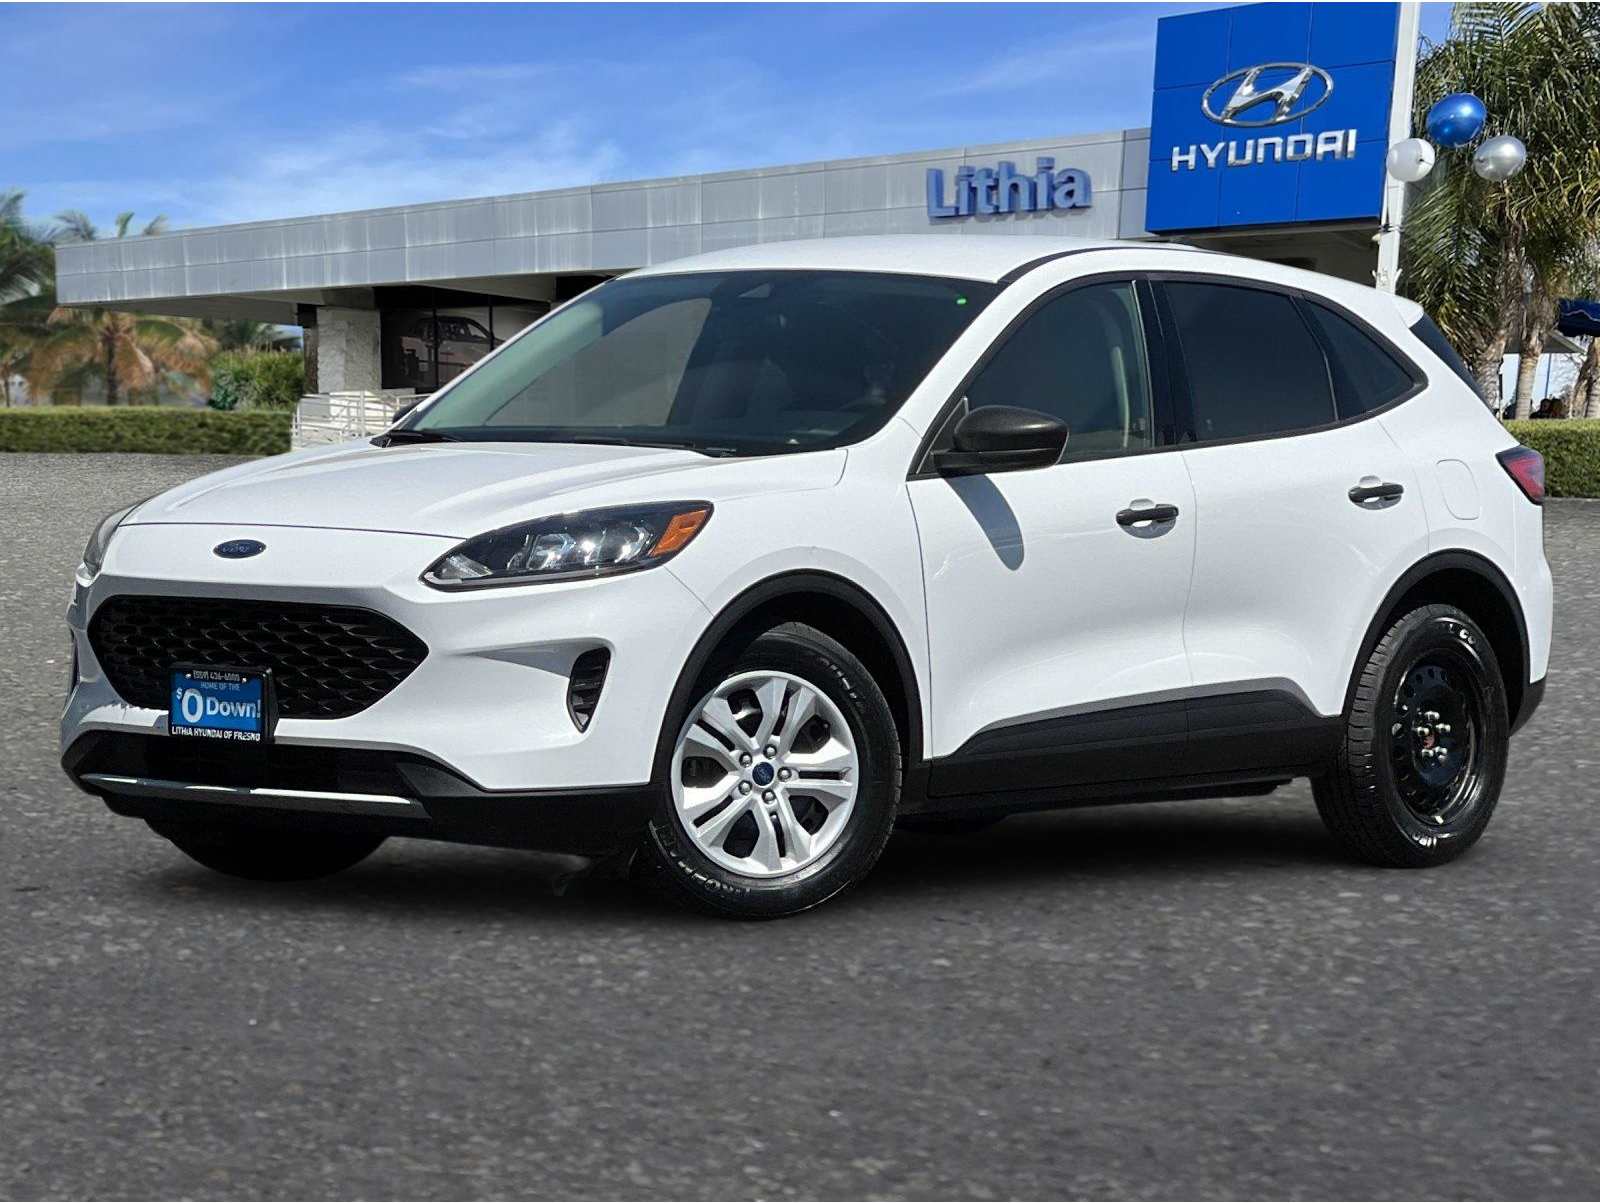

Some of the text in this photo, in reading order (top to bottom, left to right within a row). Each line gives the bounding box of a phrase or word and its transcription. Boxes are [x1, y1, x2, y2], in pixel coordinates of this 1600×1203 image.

[1171, 128, 1357, 172] HYUNDAI
[926, 157, 1092, 218] Lithia
[229, 683, 240, 691] THE
[206, 696, 261, 719] Down!
[171, 726, 193, 736] LITHIA
[194, 728, 222, 739] HYUNDAI
[224, 730, 233, 739] OF
